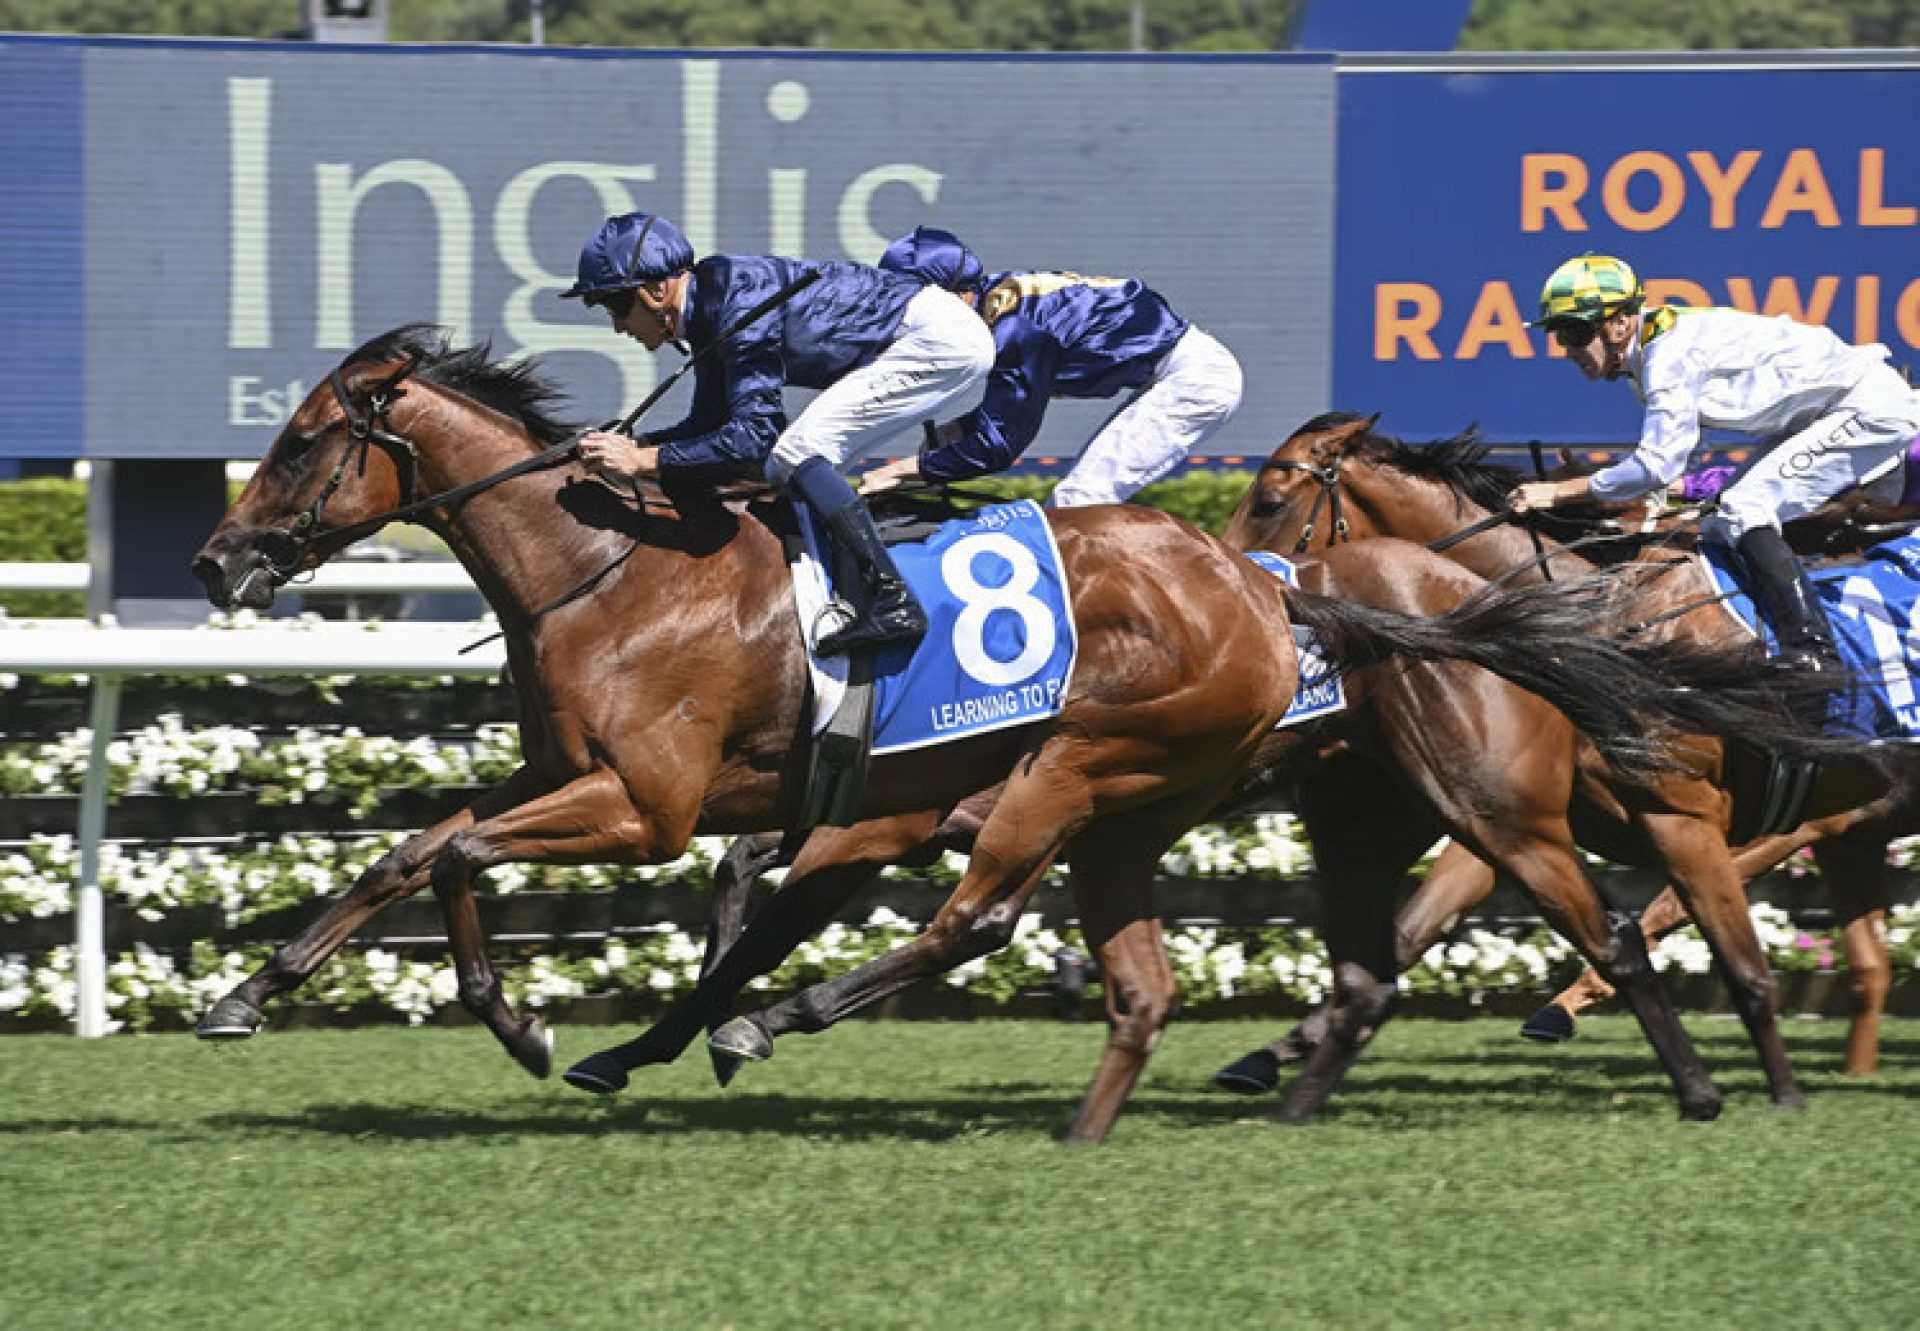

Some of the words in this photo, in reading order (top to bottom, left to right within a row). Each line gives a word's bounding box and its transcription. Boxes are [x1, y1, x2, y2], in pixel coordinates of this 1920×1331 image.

[1520, 147, 1919, 232] ROYAL
[941, 532, 1056, 687] 8
[931, 690, 1019, 731] LEARNING
[1019, 683, 1043, 709] TO
